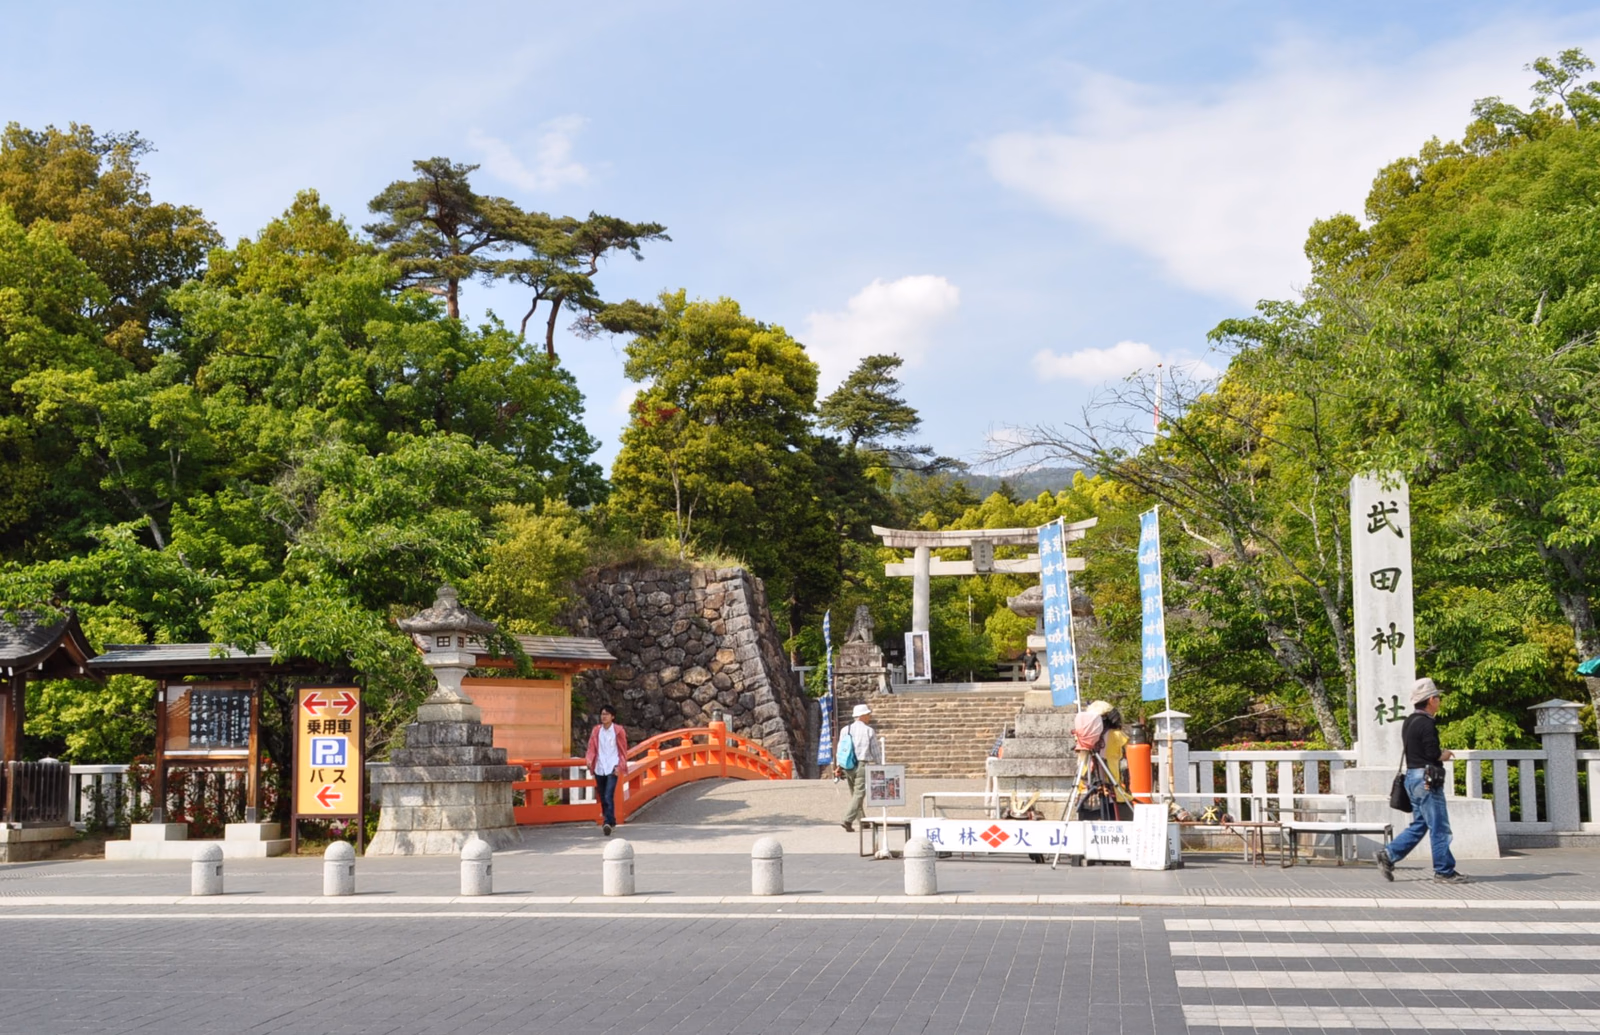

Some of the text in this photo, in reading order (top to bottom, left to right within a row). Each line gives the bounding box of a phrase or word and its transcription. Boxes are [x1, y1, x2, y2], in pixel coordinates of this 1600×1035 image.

[1366, 500, 1408, 726] 武田神社
[307, 719, 352, 735] 乗用車
[315, 740, 339, 764] P
[310, 769, 346, 783] バス
[926, 827, 1068, 847] 風林火山
